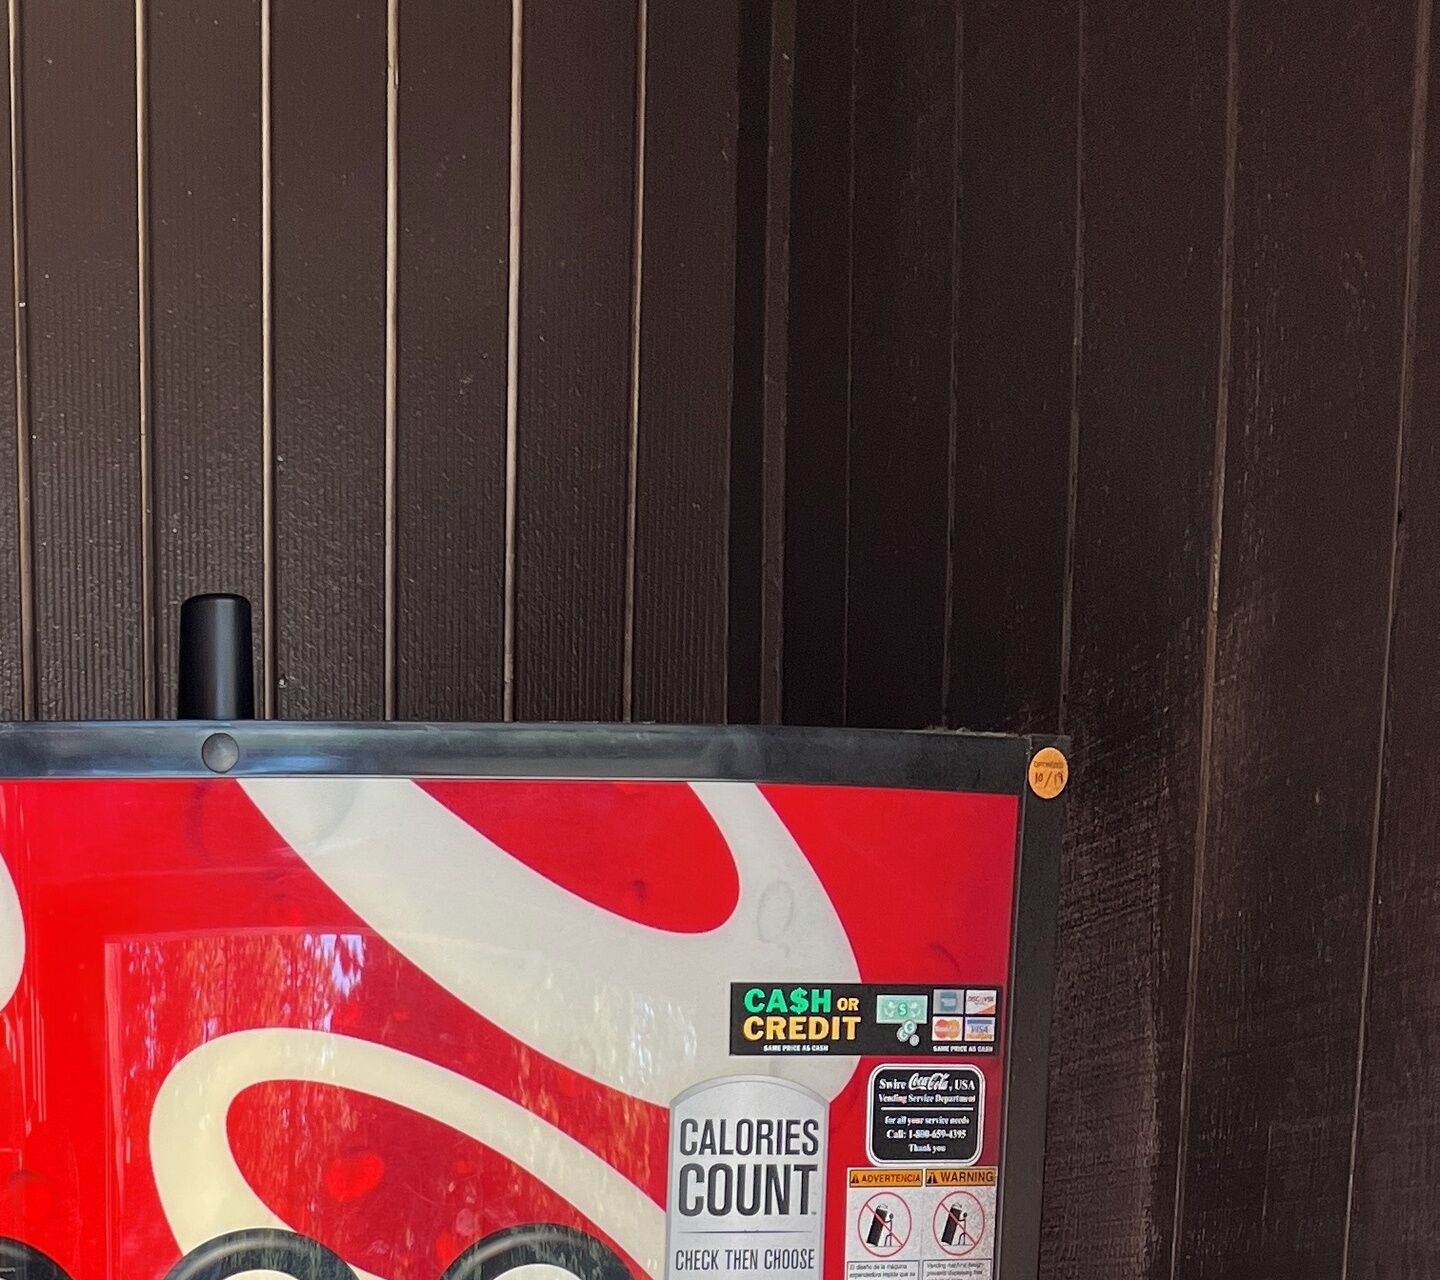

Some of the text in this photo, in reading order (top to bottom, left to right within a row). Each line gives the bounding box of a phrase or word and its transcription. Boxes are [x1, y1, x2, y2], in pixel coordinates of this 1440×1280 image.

[836, 997, 859, 1012] OR
[743, 1016, 863, 1041] CREDIT
[879, 1079, 906, 1090] Swire
[955, 1079, 975, 1090] USA
[879, 1094, 976, 1104] Vending Service Department
[680, 1118, 819, 1156] CALORIES
[886, 1130, 906, 1139] Call:
[909, 1144, 946, 1154] Thank you
[862, 1174, 920, 1183] ADVERTENCIA
[940, 1171, 994, 1182] WARNING
[678, 1163, 817, 1217] COUNT
[675, 1248, 814, 1271] CHECK THEN CHOOSE
